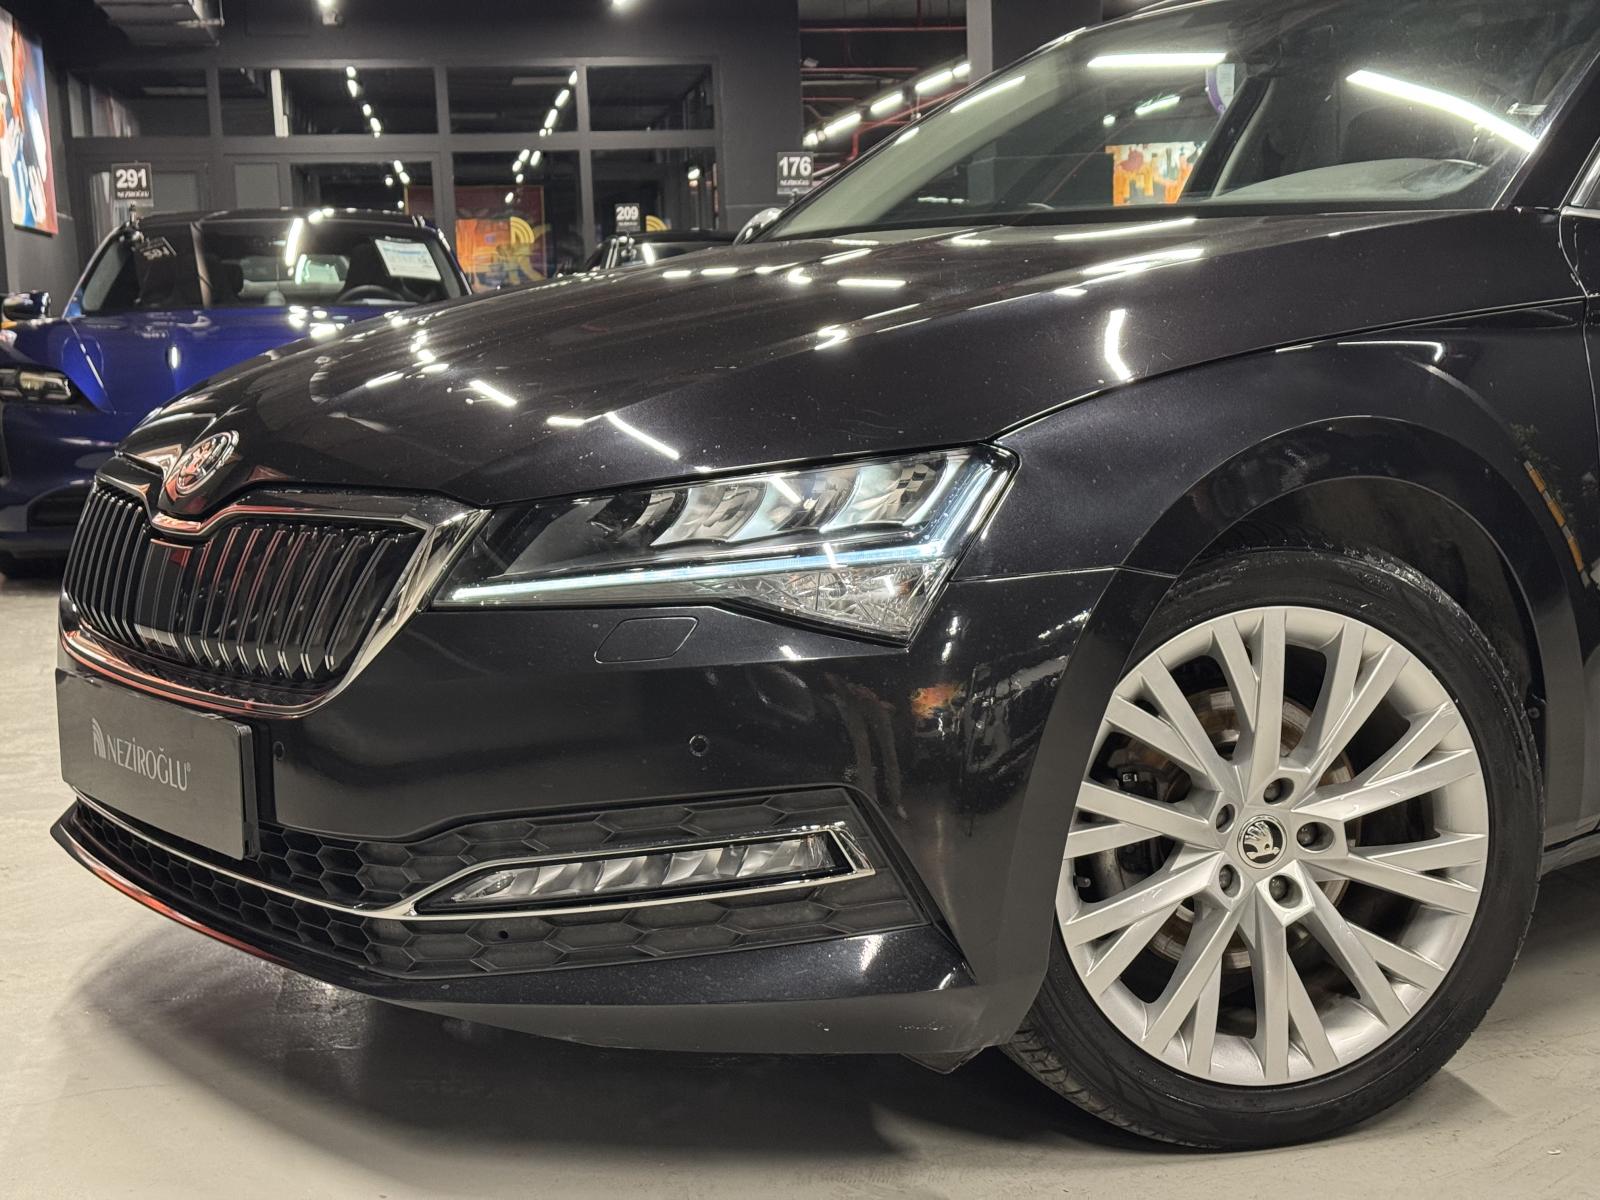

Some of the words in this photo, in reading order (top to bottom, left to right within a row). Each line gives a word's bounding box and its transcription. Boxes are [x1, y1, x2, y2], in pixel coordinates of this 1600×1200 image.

[779, 156, 811, 177] 176
[115, 168, 147, 189] 291
[616, 206, 639, 220] 209
[107, 734, 188, 791] NEZİROĞLU
